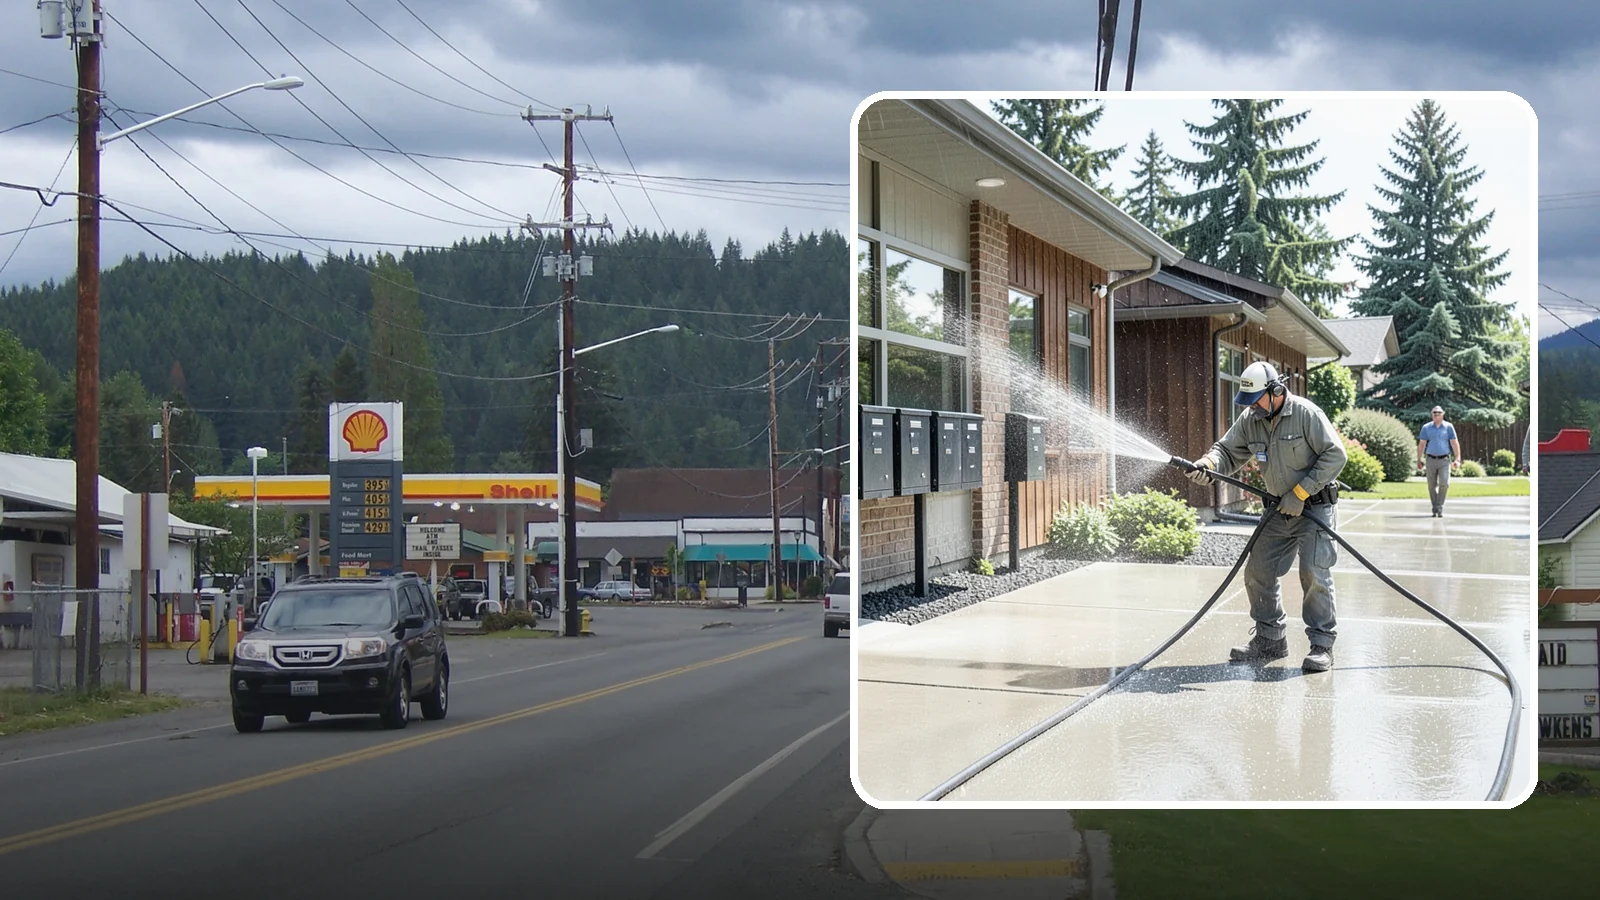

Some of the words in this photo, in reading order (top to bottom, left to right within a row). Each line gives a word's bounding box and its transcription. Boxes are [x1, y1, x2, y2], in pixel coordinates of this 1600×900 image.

[365, 480, 384, 490] 395
[490, 484, 548, 499] Shell
[365, 494, 384, 504] 405
[365, 508, 384, 518] 415
[365, 522, 384, 532] 429
[1538, 643, 1566, 665] AID
[1538, 716, 1592, 739] WKENS
